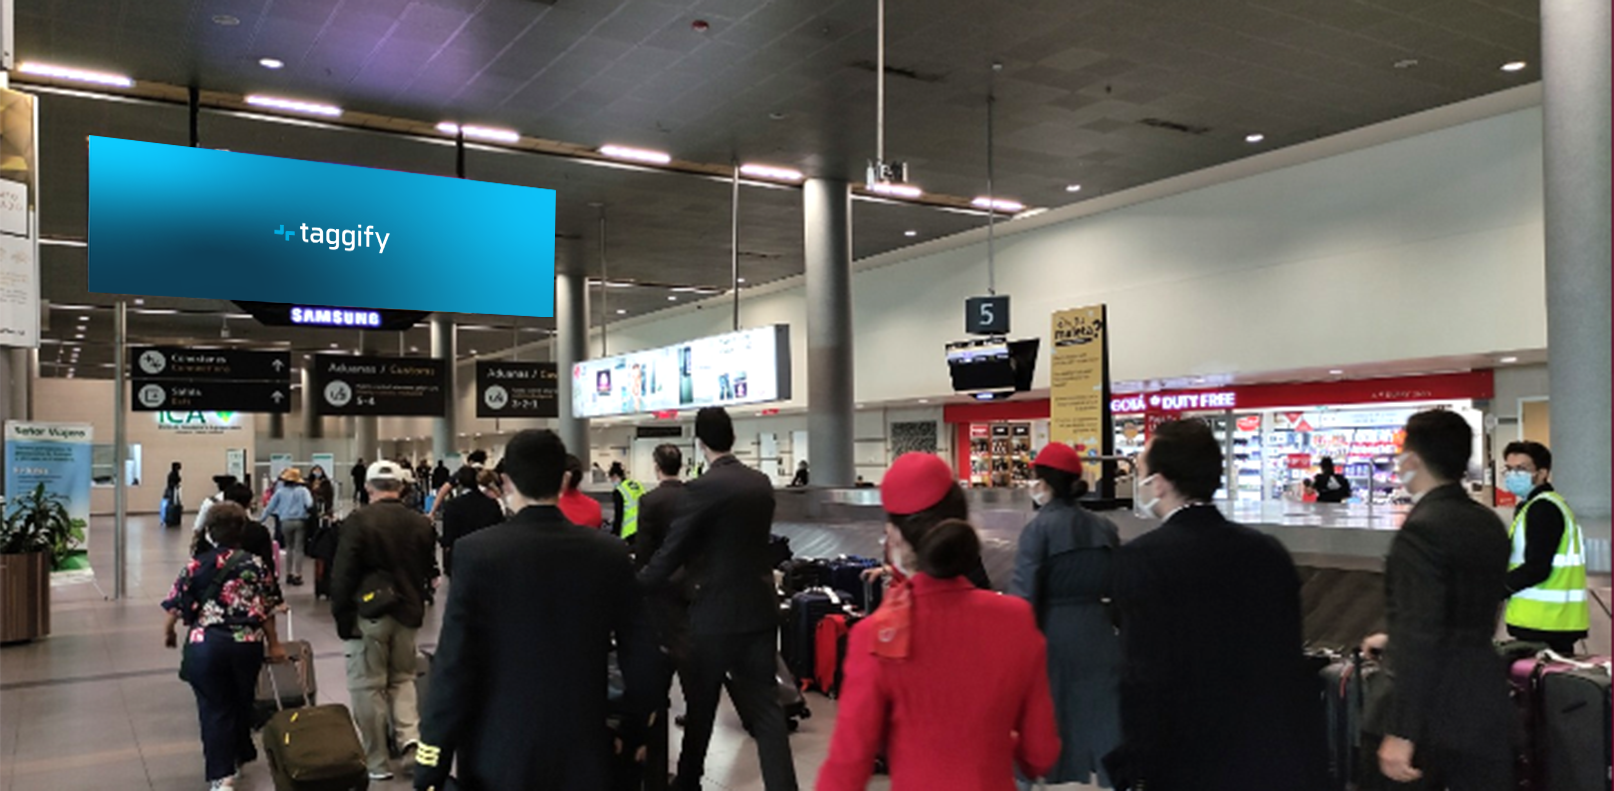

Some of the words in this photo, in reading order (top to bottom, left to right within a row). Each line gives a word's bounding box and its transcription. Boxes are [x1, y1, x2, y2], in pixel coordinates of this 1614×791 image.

[299, 222, 391, 254] taggify
[291, 307, 381, 326] SAMSUNG
[979, 303, 994, 325] 5
[1162, 394, 1199, 409] DUTY
[1200, 392, 1236, 407] FREE
